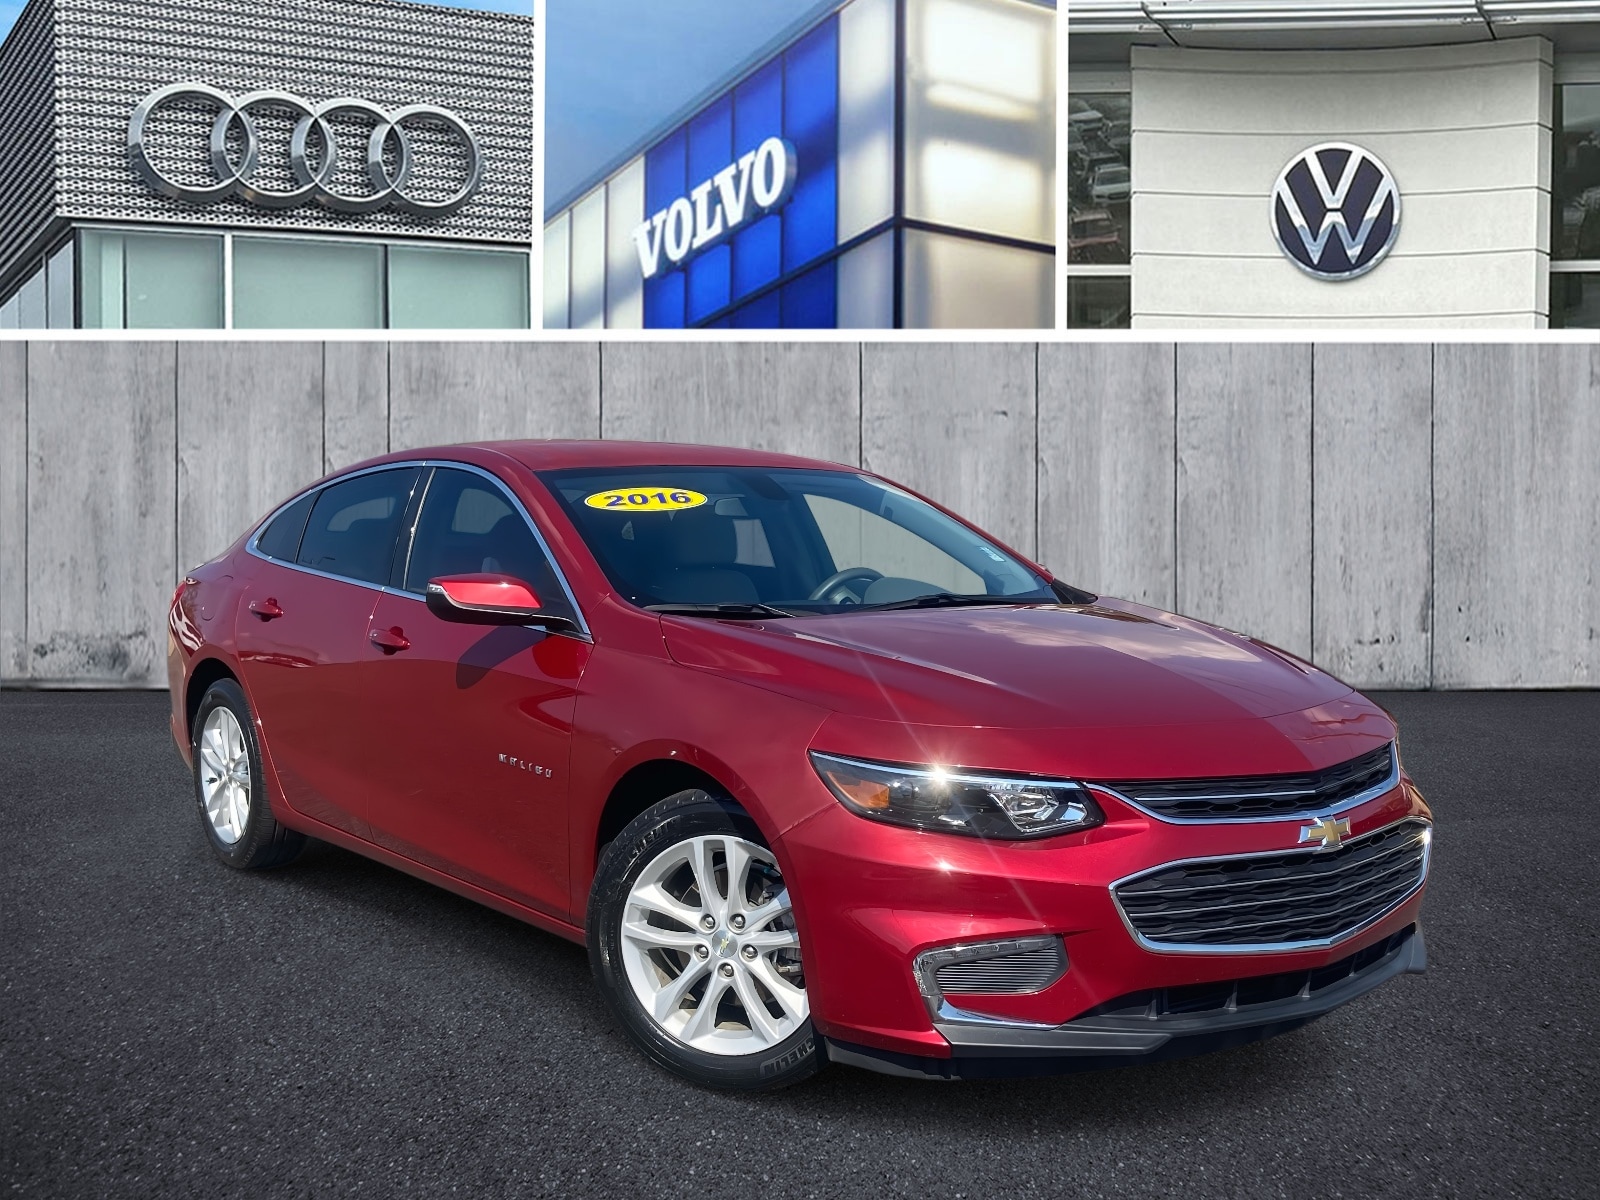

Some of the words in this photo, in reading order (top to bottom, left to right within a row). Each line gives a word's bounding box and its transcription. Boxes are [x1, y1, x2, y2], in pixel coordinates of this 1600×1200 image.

[632, 136, 791, 279] VOLVO
[1272, 143, 1400, 278] VW
[603, 491, 692, 507] 2016
[763, 1037, 816, 1076] CHELIN
